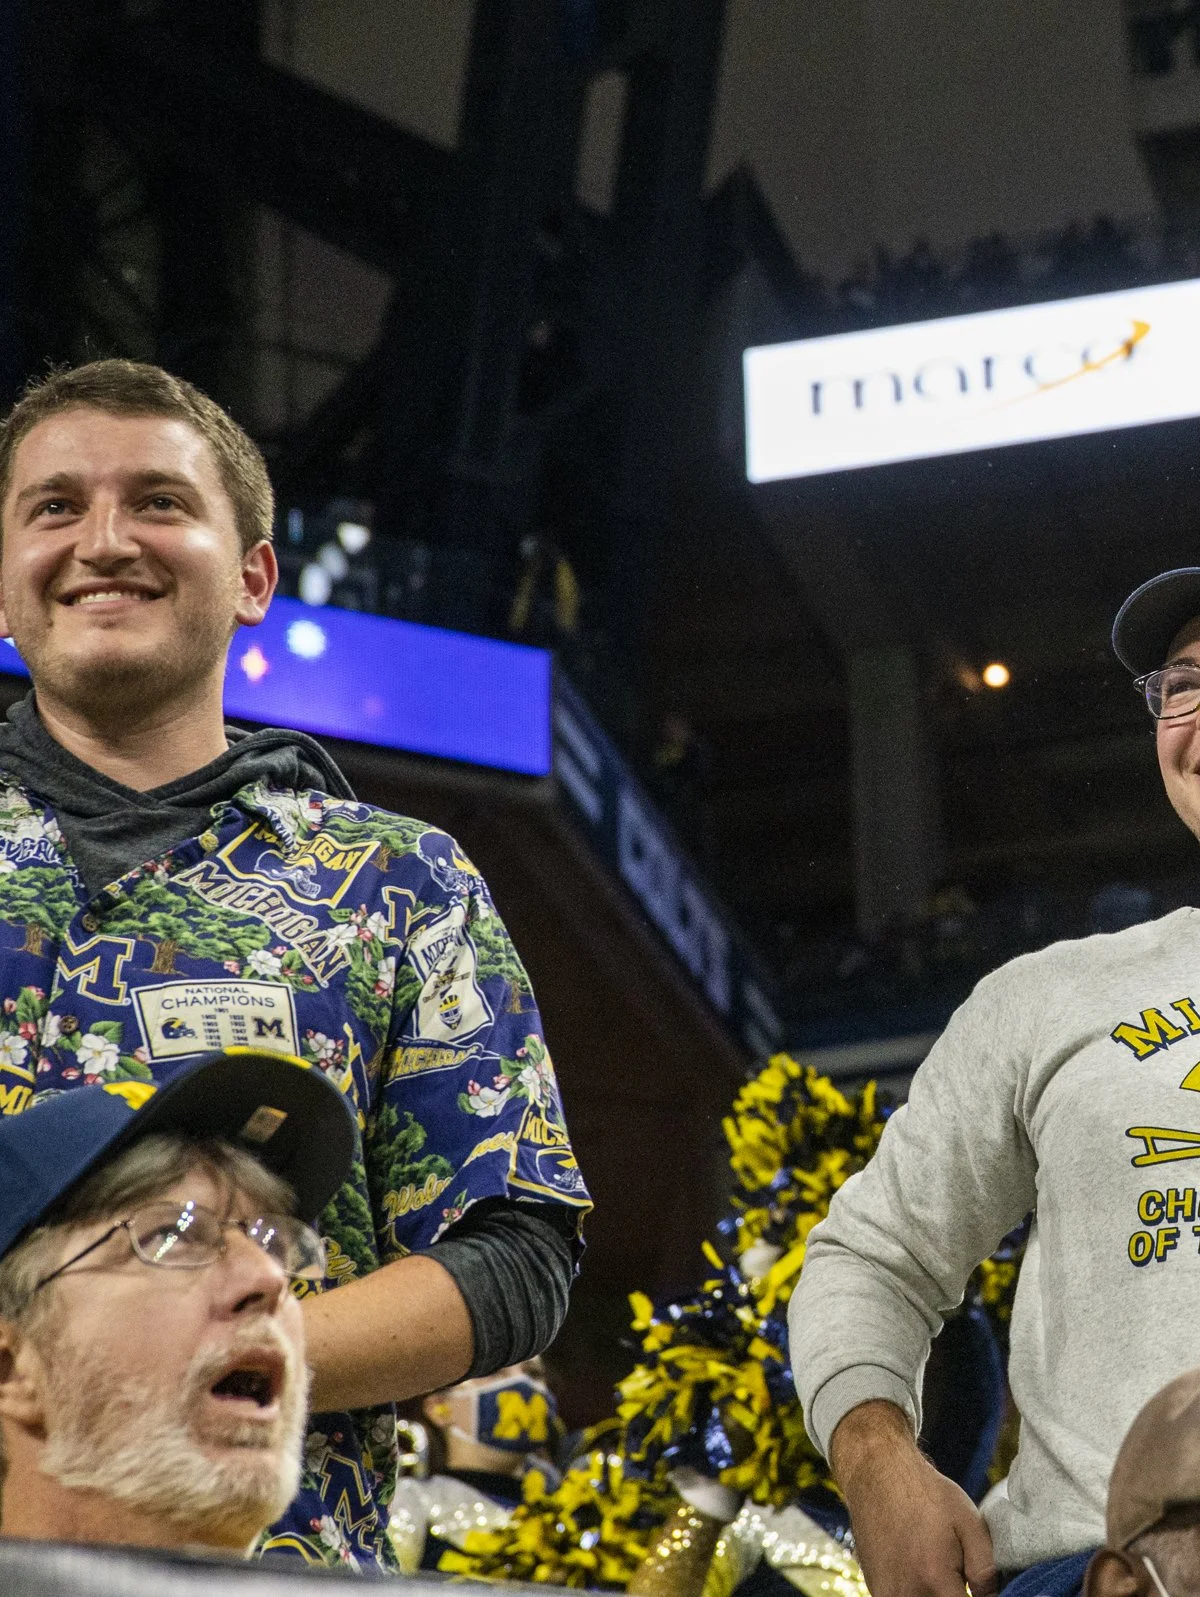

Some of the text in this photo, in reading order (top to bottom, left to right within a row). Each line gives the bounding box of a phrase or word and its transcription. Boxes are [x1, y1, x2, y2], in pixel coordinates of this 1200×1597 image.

[169, 861, 351, 983] MICHIGAN
[161, 995, 275, 1010] CHAMPIONS
[254, 1017, 285, 1038] M
[1128, 1227, 1180, 1267] OF
[492, 1390, 548, 1441] M
